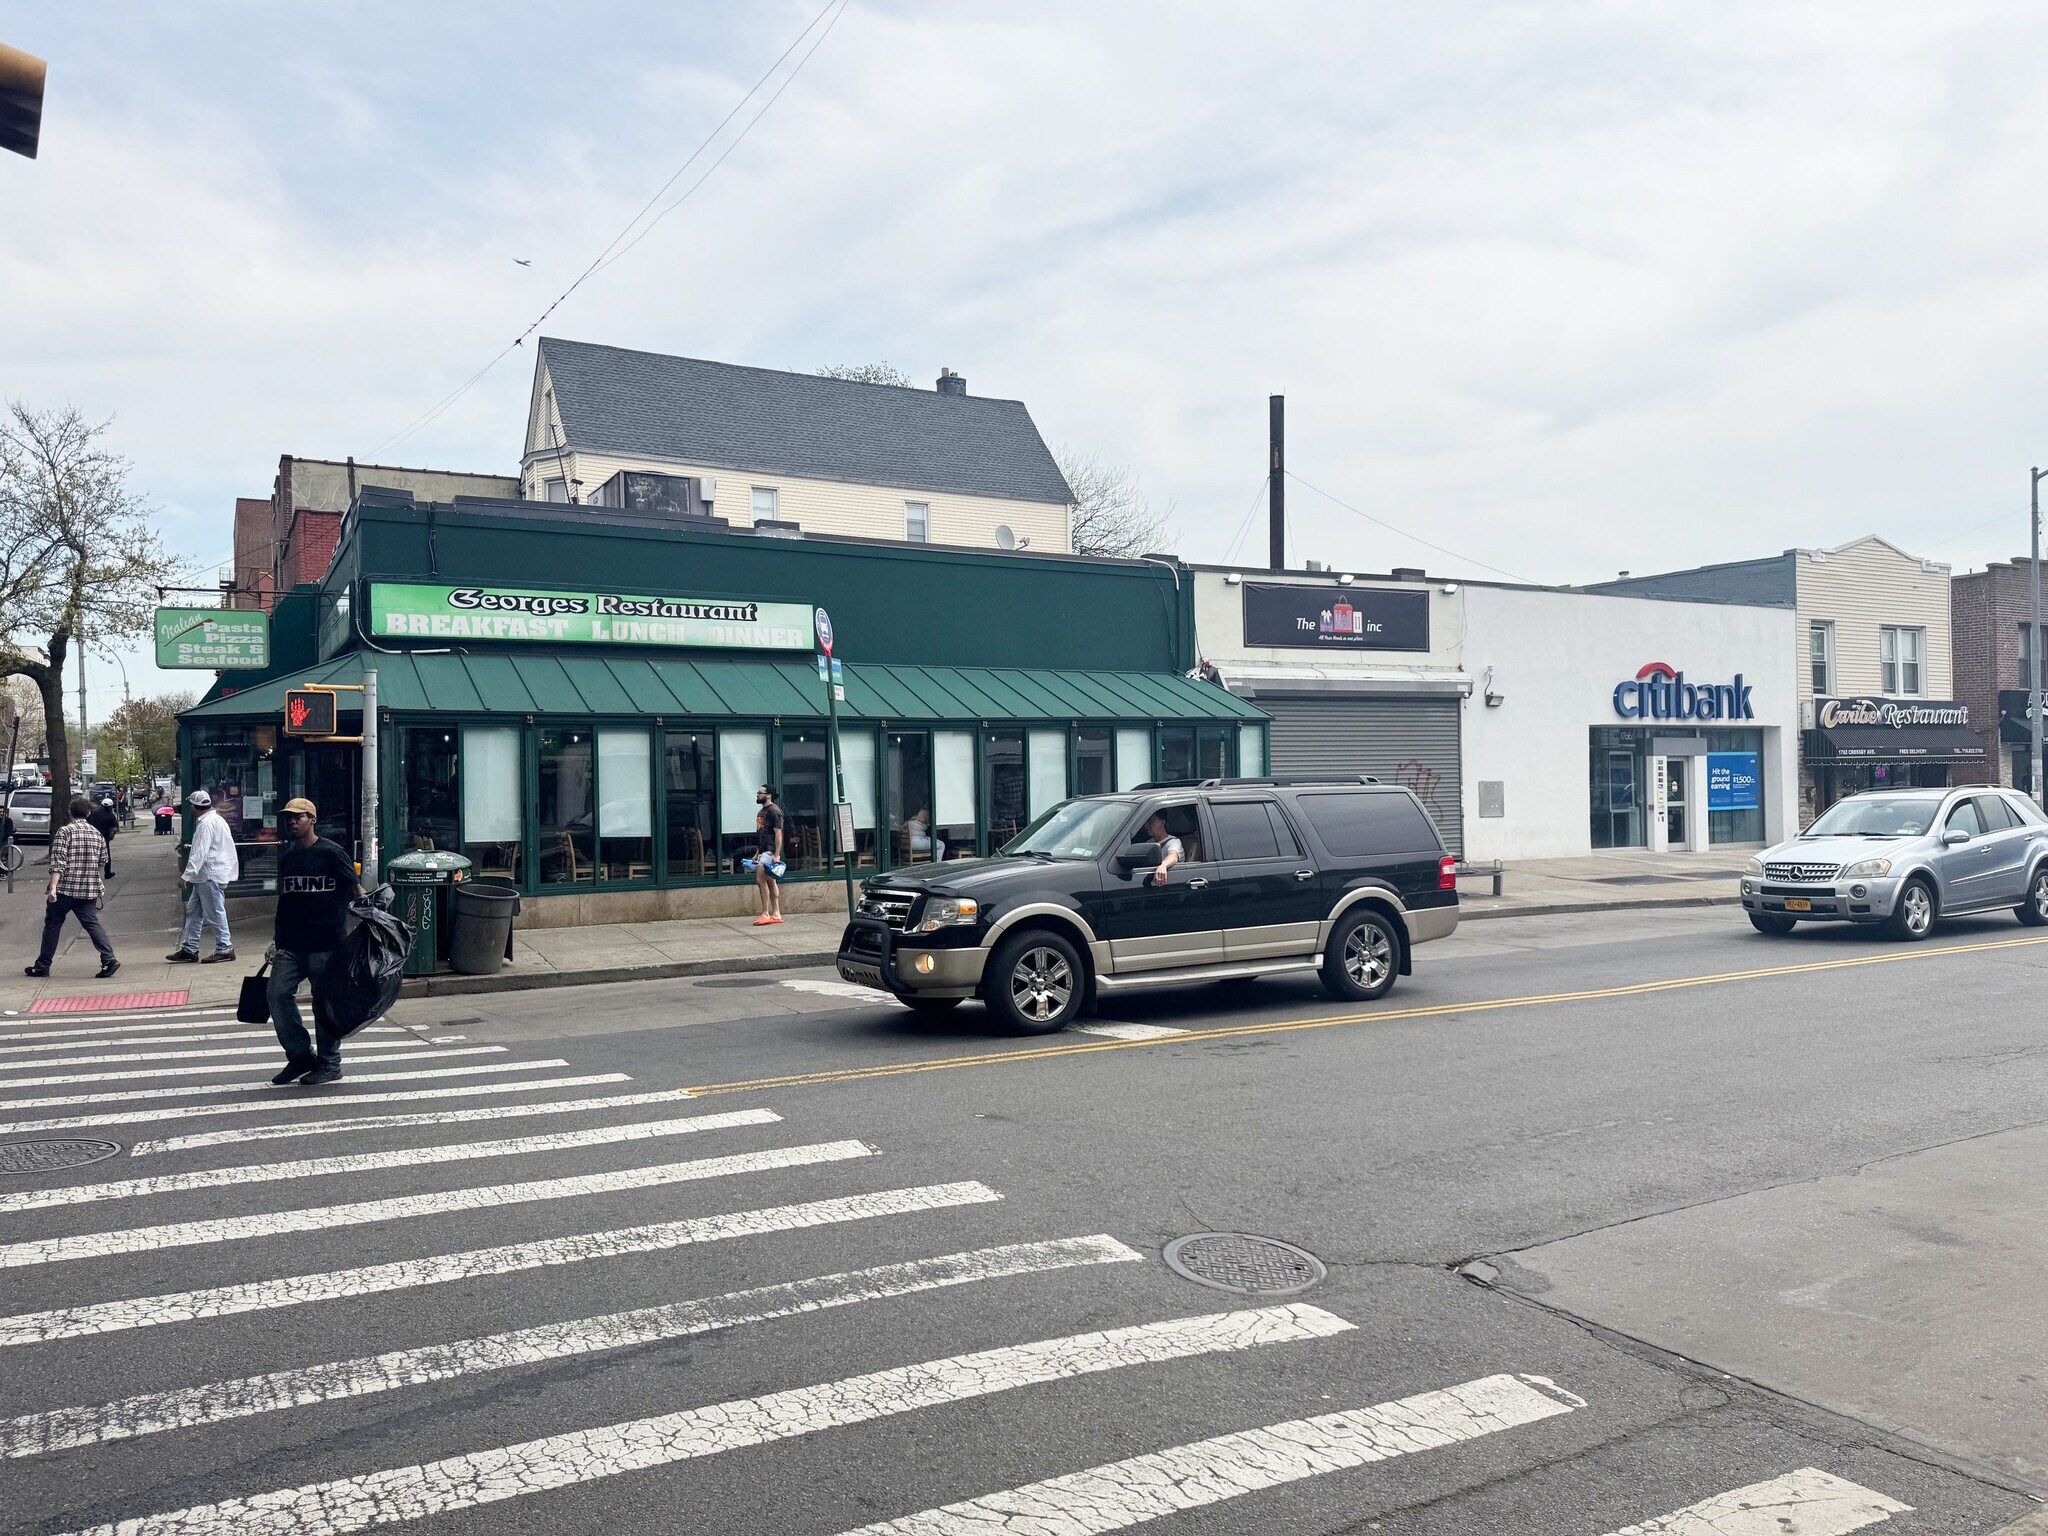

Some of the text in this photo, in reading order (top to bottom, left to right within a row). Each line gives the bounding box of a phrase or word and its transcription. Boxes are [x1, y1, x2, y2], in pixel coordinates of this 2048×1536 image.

[448, 588, 757, 621] Georges Restaurant
[161, 613, 203, 639] Italian
[203, 622, 264, 633] Pasta
[386, 613, 804, 647] BREAKFAST LUNCH DINNER
[1296, 617, 1316, 630] The
[1366, 620, 1382, 632] inc
[205, 632, 264, 644] Pizza
[178, 643, 264, 654] Steak &
[178, 654, 264, 665] Seafood
[1613, 670, 1754, 720] citibank
[1820, 700, 1969, 729] Caribe Restaurant
[1711, 775, 1730, 783] ground
